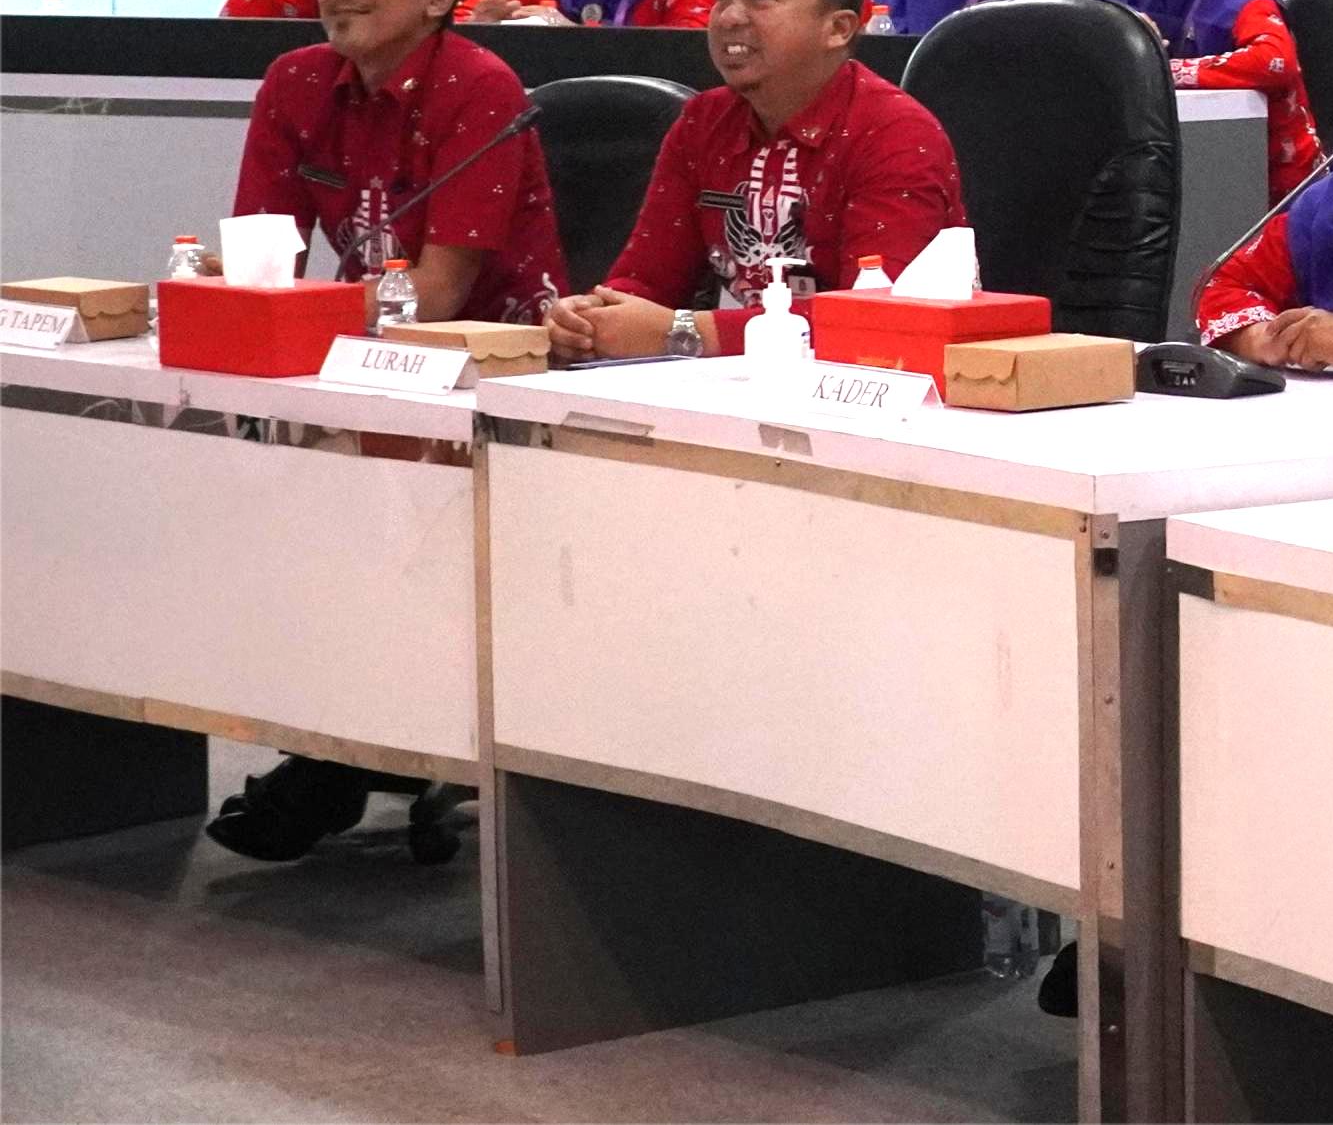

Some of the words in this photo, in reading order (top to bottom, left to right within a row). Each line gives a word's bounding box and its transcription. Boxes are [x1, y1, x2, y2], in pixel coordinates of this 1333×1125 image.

[10, 310, 68, 334] TAPEM
[361, 348, 426, 375] LURAH
[812, 375, 889, 408] KADER
